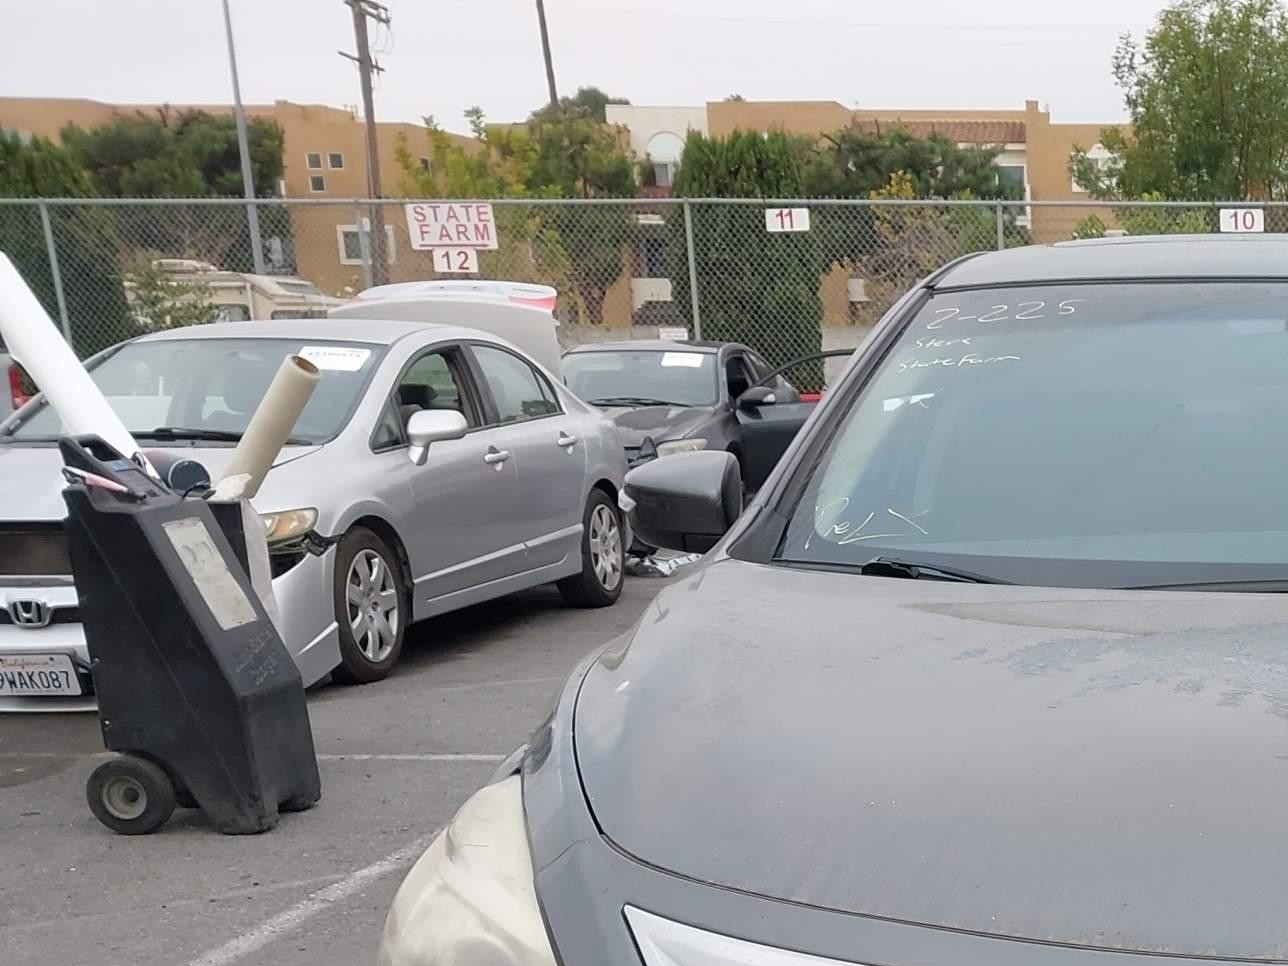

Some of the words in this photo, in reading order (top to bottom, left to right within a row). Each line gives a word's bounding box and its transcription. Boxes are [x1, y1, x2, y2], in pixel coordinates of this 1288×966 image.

[413, 205, 490, 222] STATE
[775, 209, 794, 229] 11
[1229, 210, 1255, 230] 10
[419, 224, 490, 241] FARM
[441, 250, 471, 271] 12
